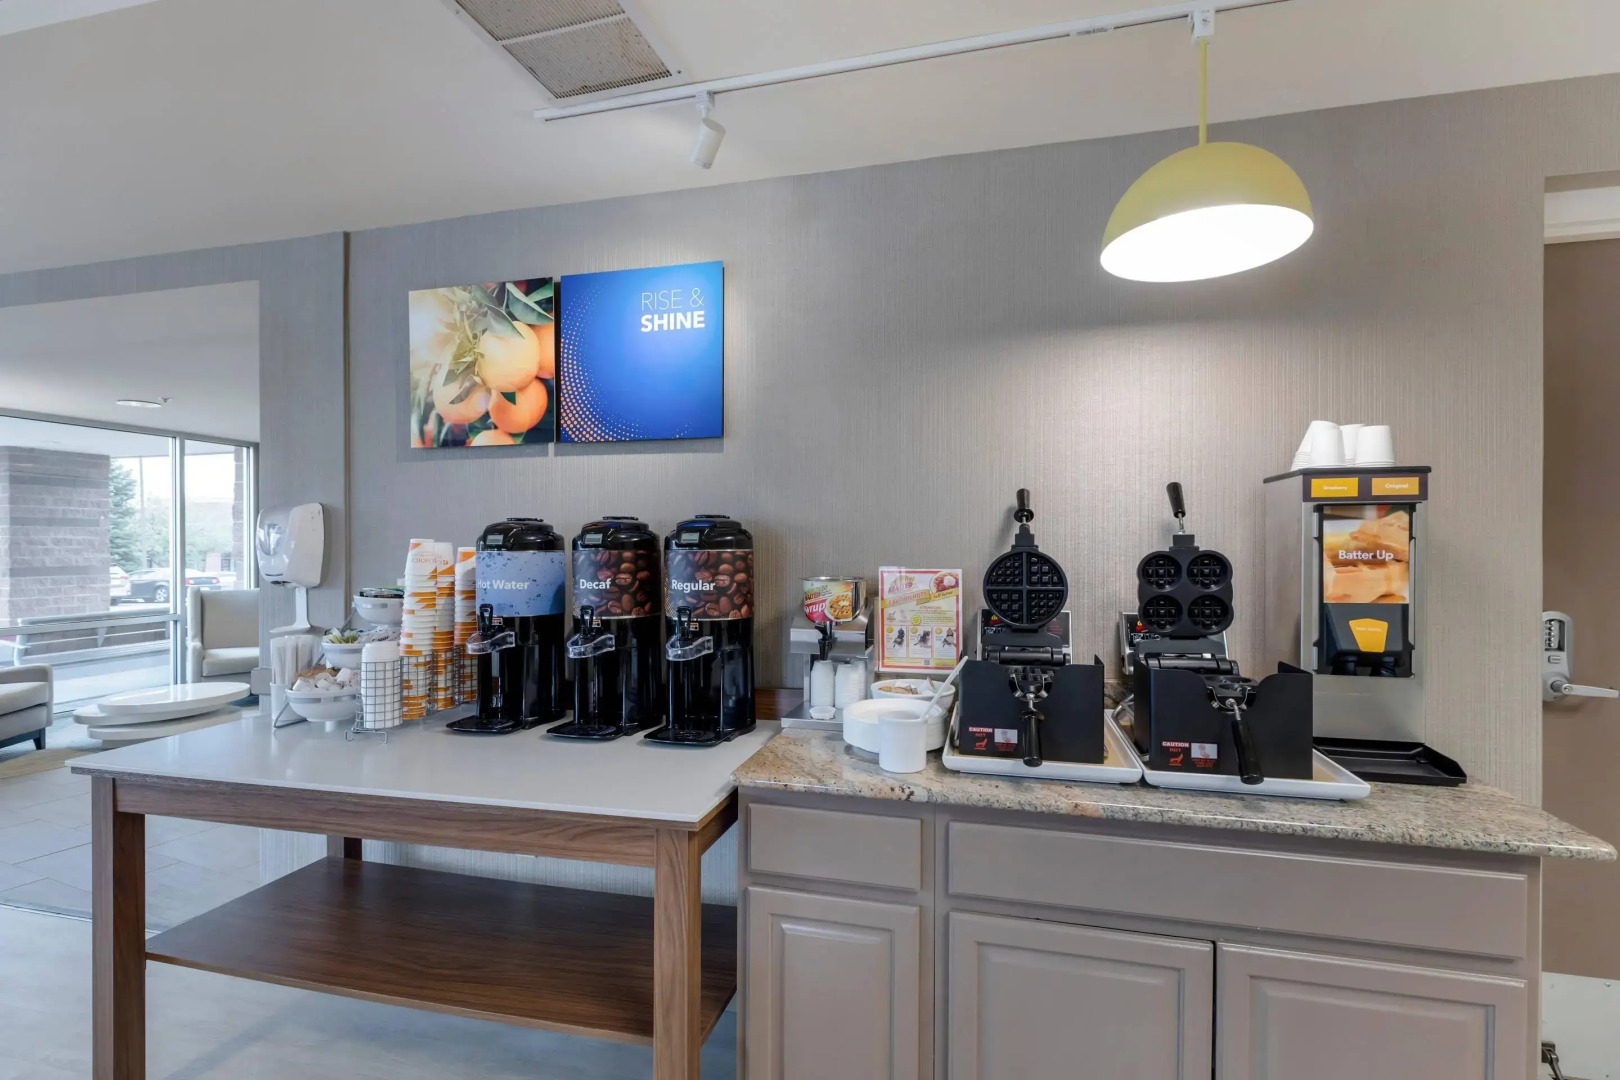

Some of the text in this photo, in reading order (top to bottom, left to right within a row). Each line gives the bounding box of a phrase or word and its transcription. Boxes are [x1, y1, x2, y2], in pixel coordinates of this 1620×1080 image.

[641, 287, 705, 311] RISE &
[640, 310, 705, 333] SHINE
[1338, 549, 1394, 561] Batter Up
[477, 579, 530, 590] Hot Water
[579, 578, 612, 590] Decaf
[671, 579, 716, 594] Regular
